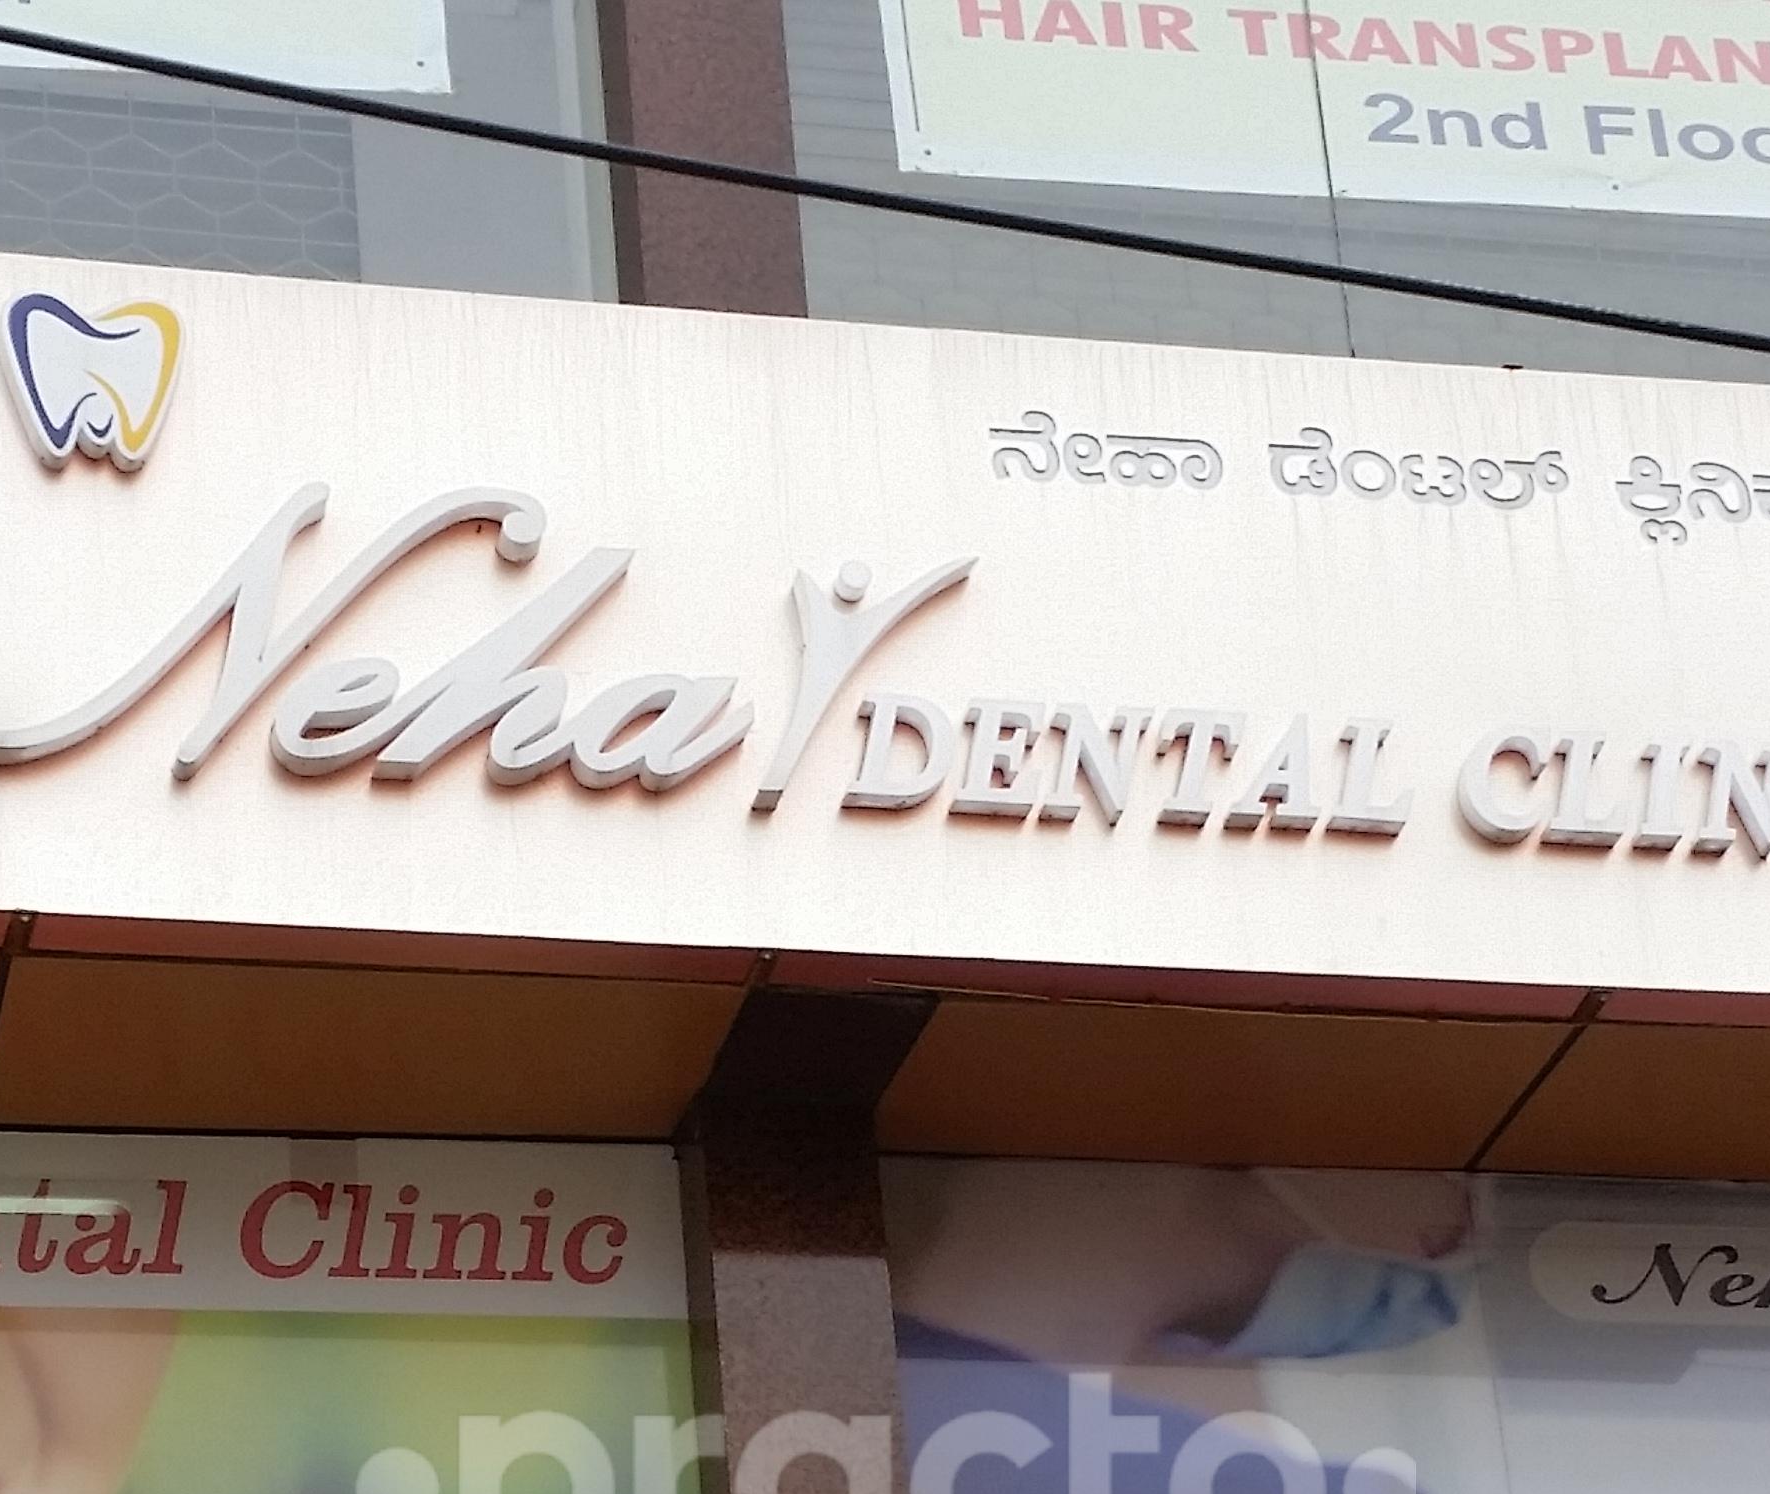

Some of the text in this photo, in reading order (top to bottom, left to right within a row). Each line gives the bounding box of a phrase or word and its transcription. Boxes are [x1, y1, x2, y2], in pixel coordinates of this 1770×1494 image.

[958, 0, 1200, 52] HAIR
[1363, 93, 1548, 151] 2nd
[988, 410, 1223, 491] ನೇಹಾ
[1267, 427, 1570, 511] ಡೆಂಟಲ್
[839, 691, 1414, 840] DENTAL
[240, 1181, 627, 1284] Clinic
